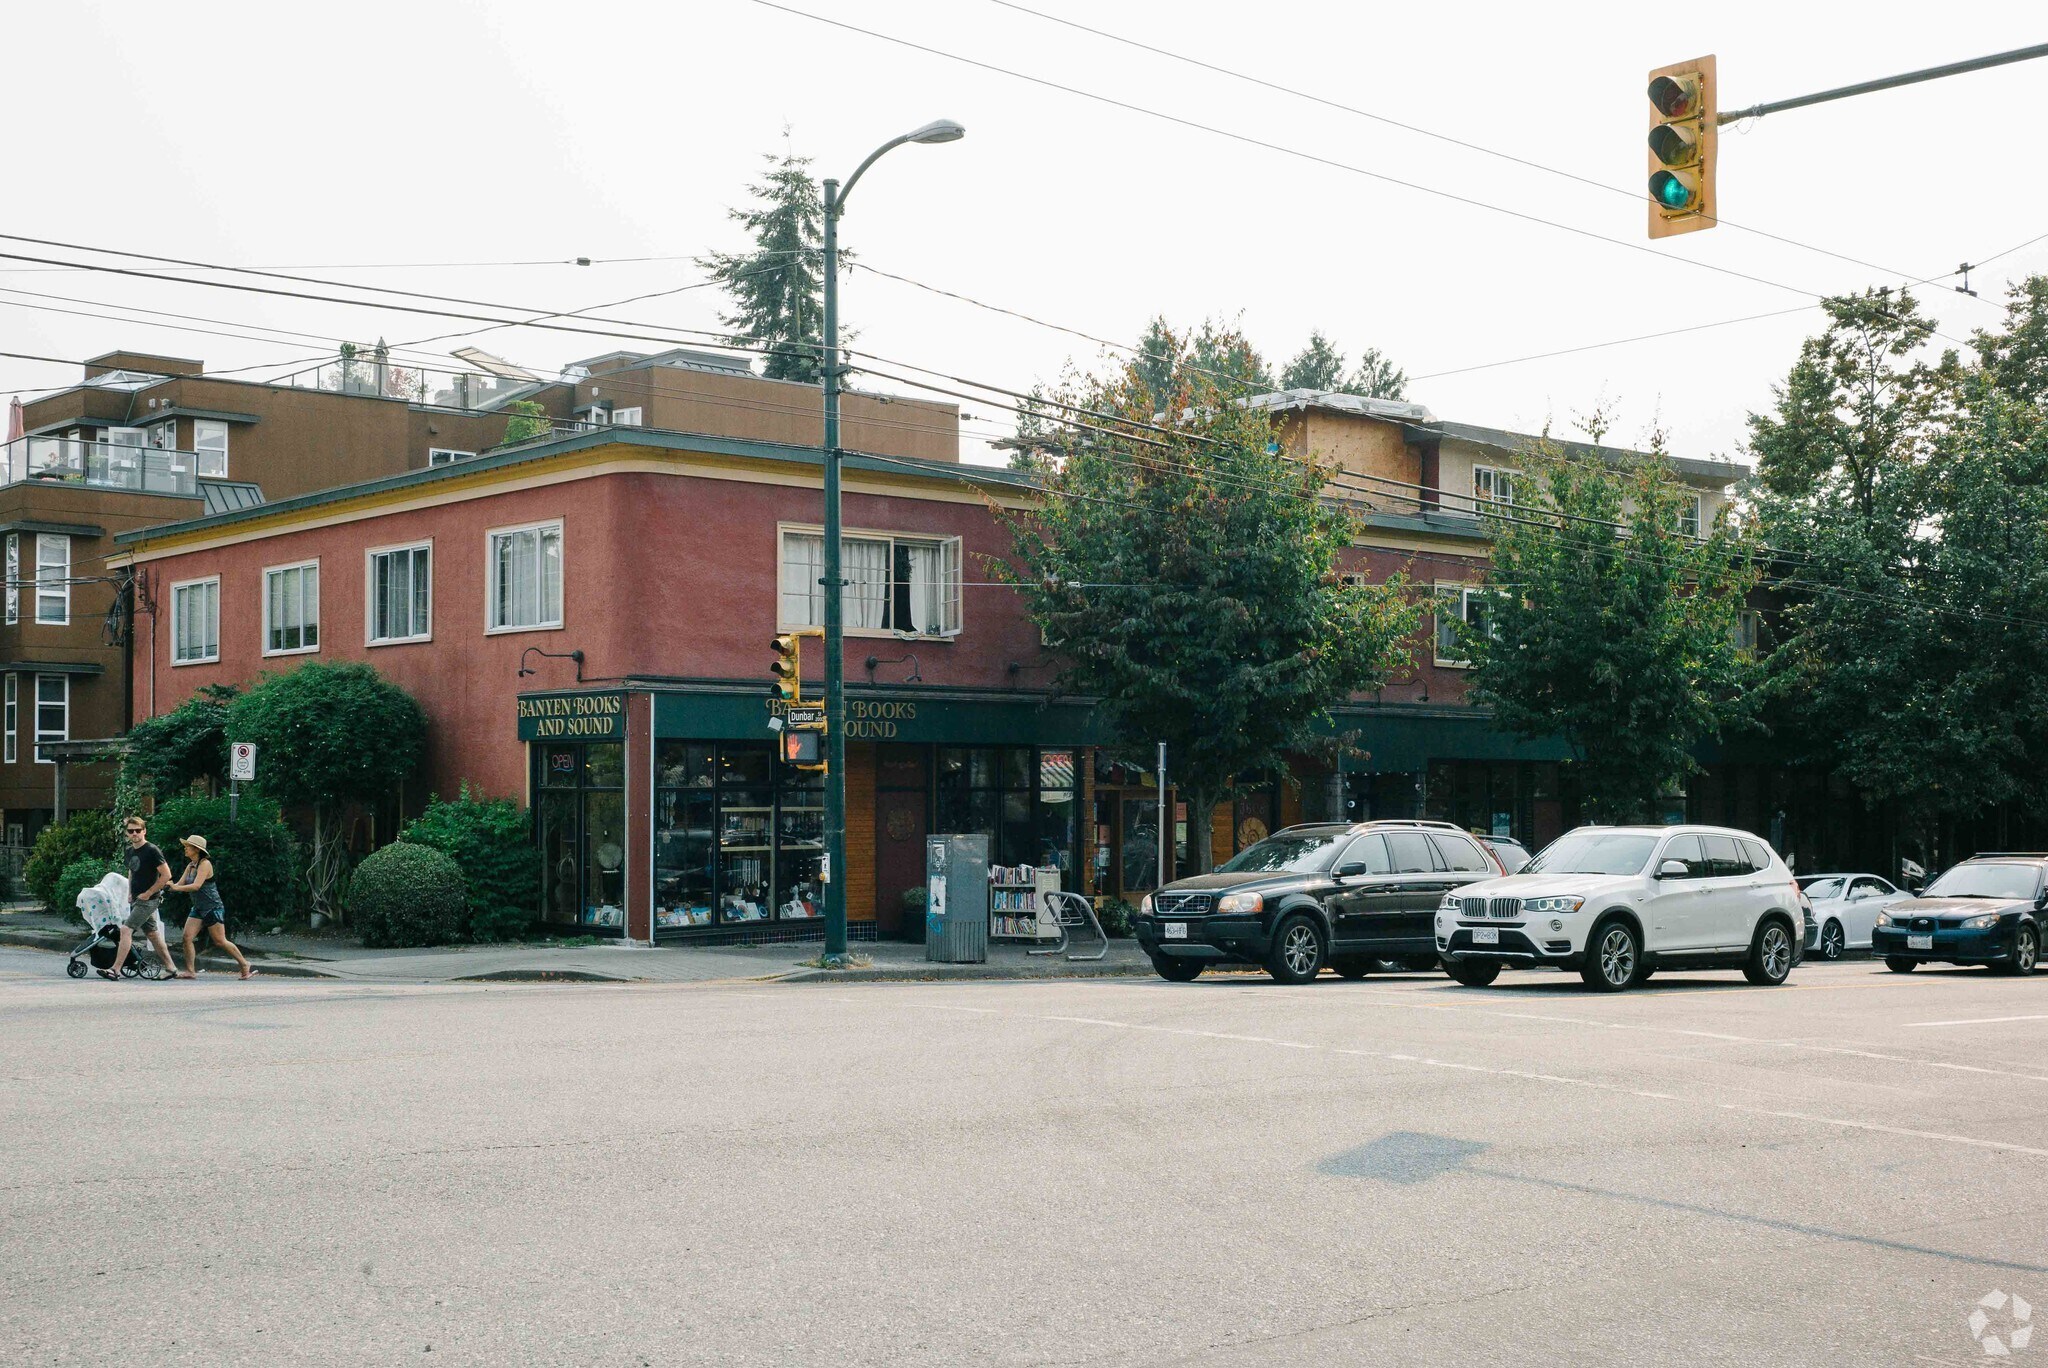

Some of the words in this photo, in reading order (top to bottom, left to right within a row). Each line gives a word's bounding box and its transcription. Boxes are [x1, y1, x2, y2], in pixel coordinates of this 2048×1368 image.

[517, 698, 571, 718] BANYEN
[573, 695, 620, 715] BOOKS
[791, 711, 814, 721] Dunbar
[852, 700, 916, 719] BOOKS
[536, 718, 565, 736] AND
[567, 716, 613, 736] SOUND
[843, 720, 898, 739] OUND
[551, 754, 575, 769] OPEN
